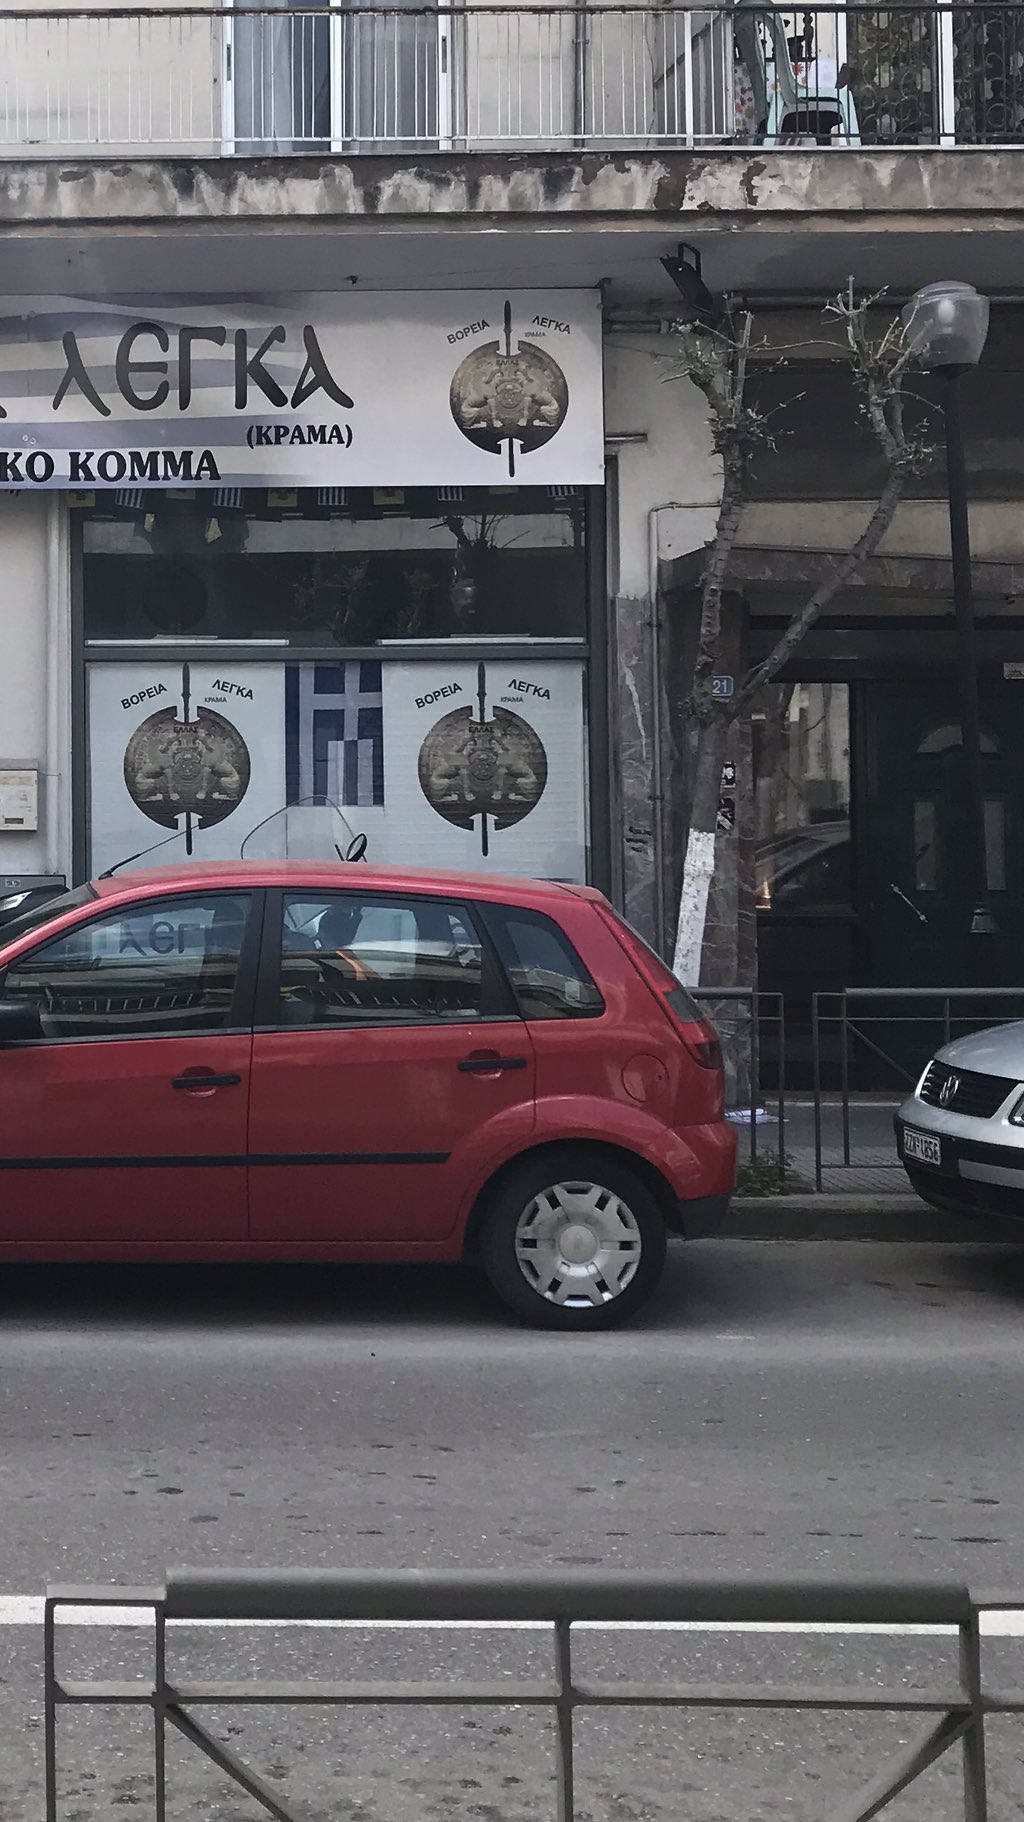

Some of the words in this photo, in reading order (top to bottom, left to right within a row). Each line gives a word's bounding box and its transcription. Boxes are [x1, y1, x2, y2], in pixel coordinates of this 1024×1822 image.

[446, 319, 491, 345] ΒΟΡΕΙΑ
[532, 315, 571, 335] ΛΕΓΚΑ
[52, 321, 355, 418] ΛΕΓΚΑ
[246, 424, 353, 450] (ΚΡΑΜΑ)
[68, 449, 223, 482] ΚΟΜΜΑ
[120, 683, 168, 710] ΒΟΡΕΙΑ
[211, 679, 254, 701] ΛΕΓΚΑ
[414, 682, 463, 709] ΒΟΡΕΙΑ
[507, 679, 551, 700] ΛΕΓΚΑ
[712, 679, 728, 694] 21
[119, 921, 201, 956] ΛΕΓ
